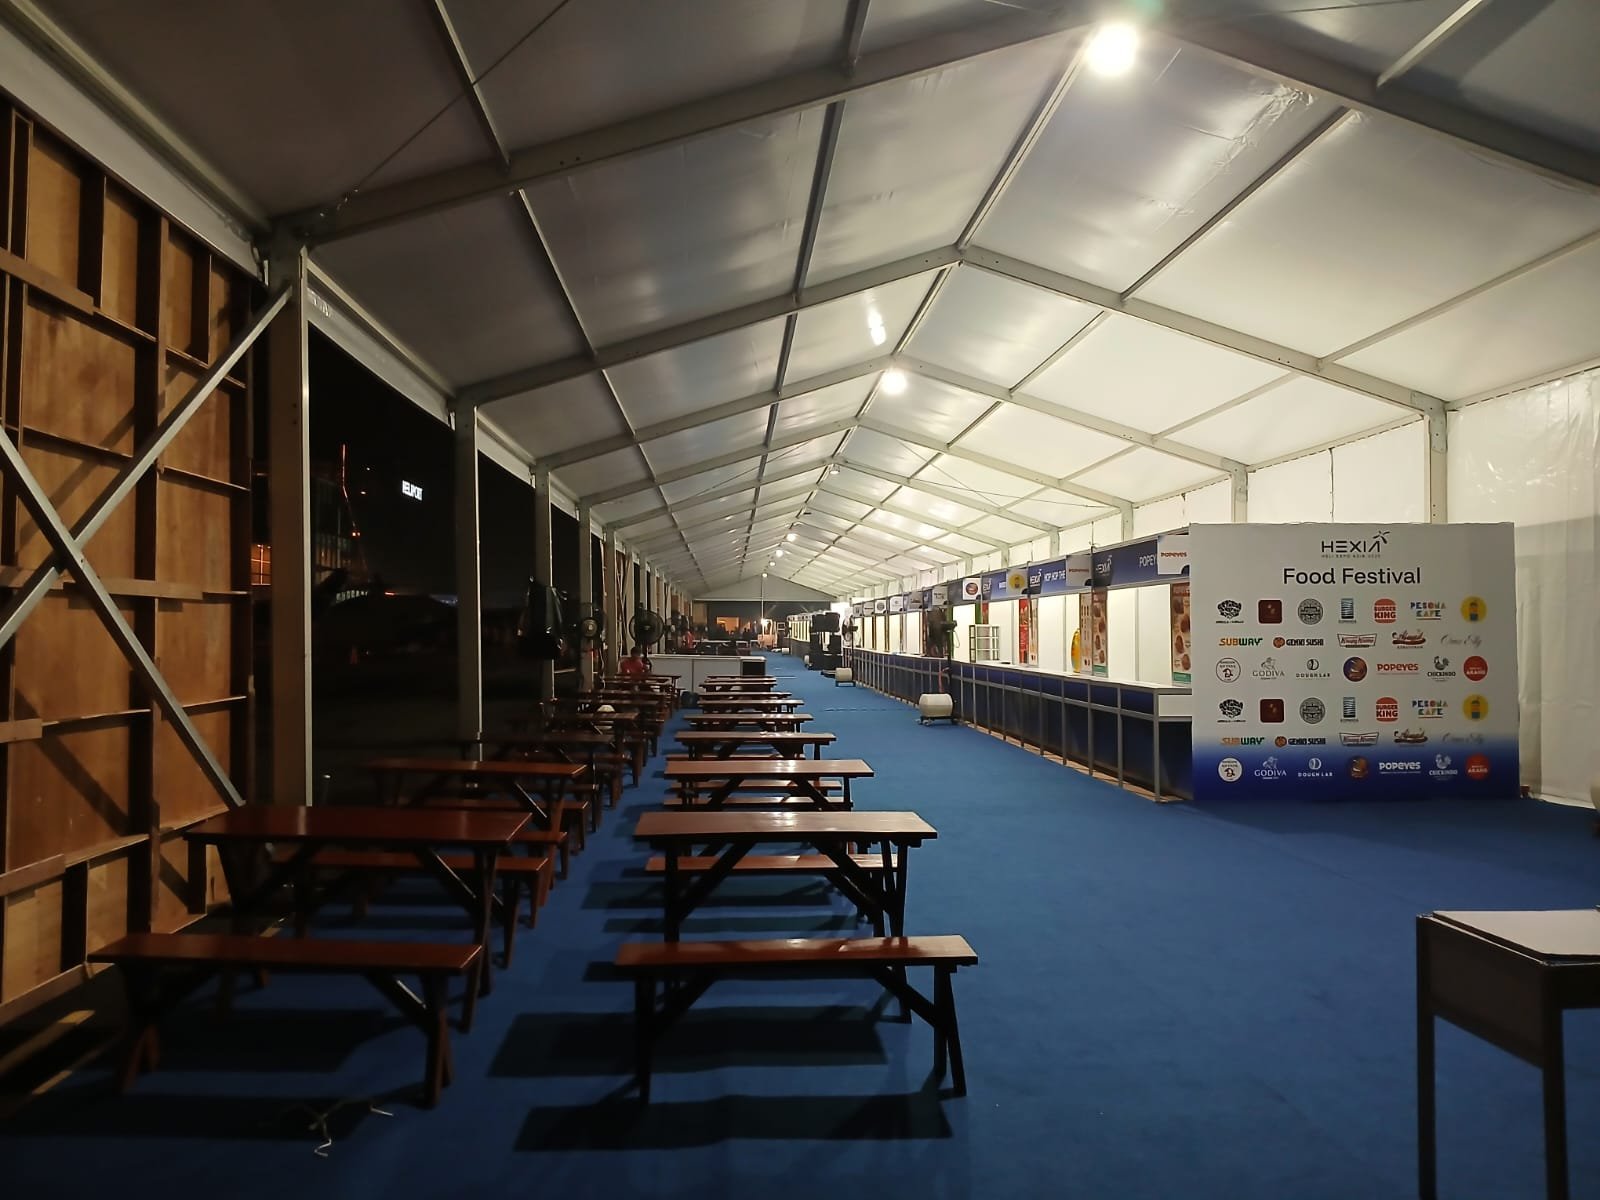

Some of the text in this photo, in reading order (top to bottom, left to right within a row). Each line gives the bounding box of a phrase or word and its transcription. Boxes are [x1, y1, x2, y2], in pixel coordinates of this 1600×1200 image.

[1321, 540, 1381, 553] HEXIA
[1283, 567, 1421, 584] Food Festival
[1374, 611, 1396, 619] KING
[1219, 637, 1263, 646] SUBWAY
[1305, 638, 1324, 646] SUSHI
[1376, 710, 1398, 718] KING
[1221, 737, 1265, 746] SUBWAY
[1254, 769, 1287, 777] GODIVA
